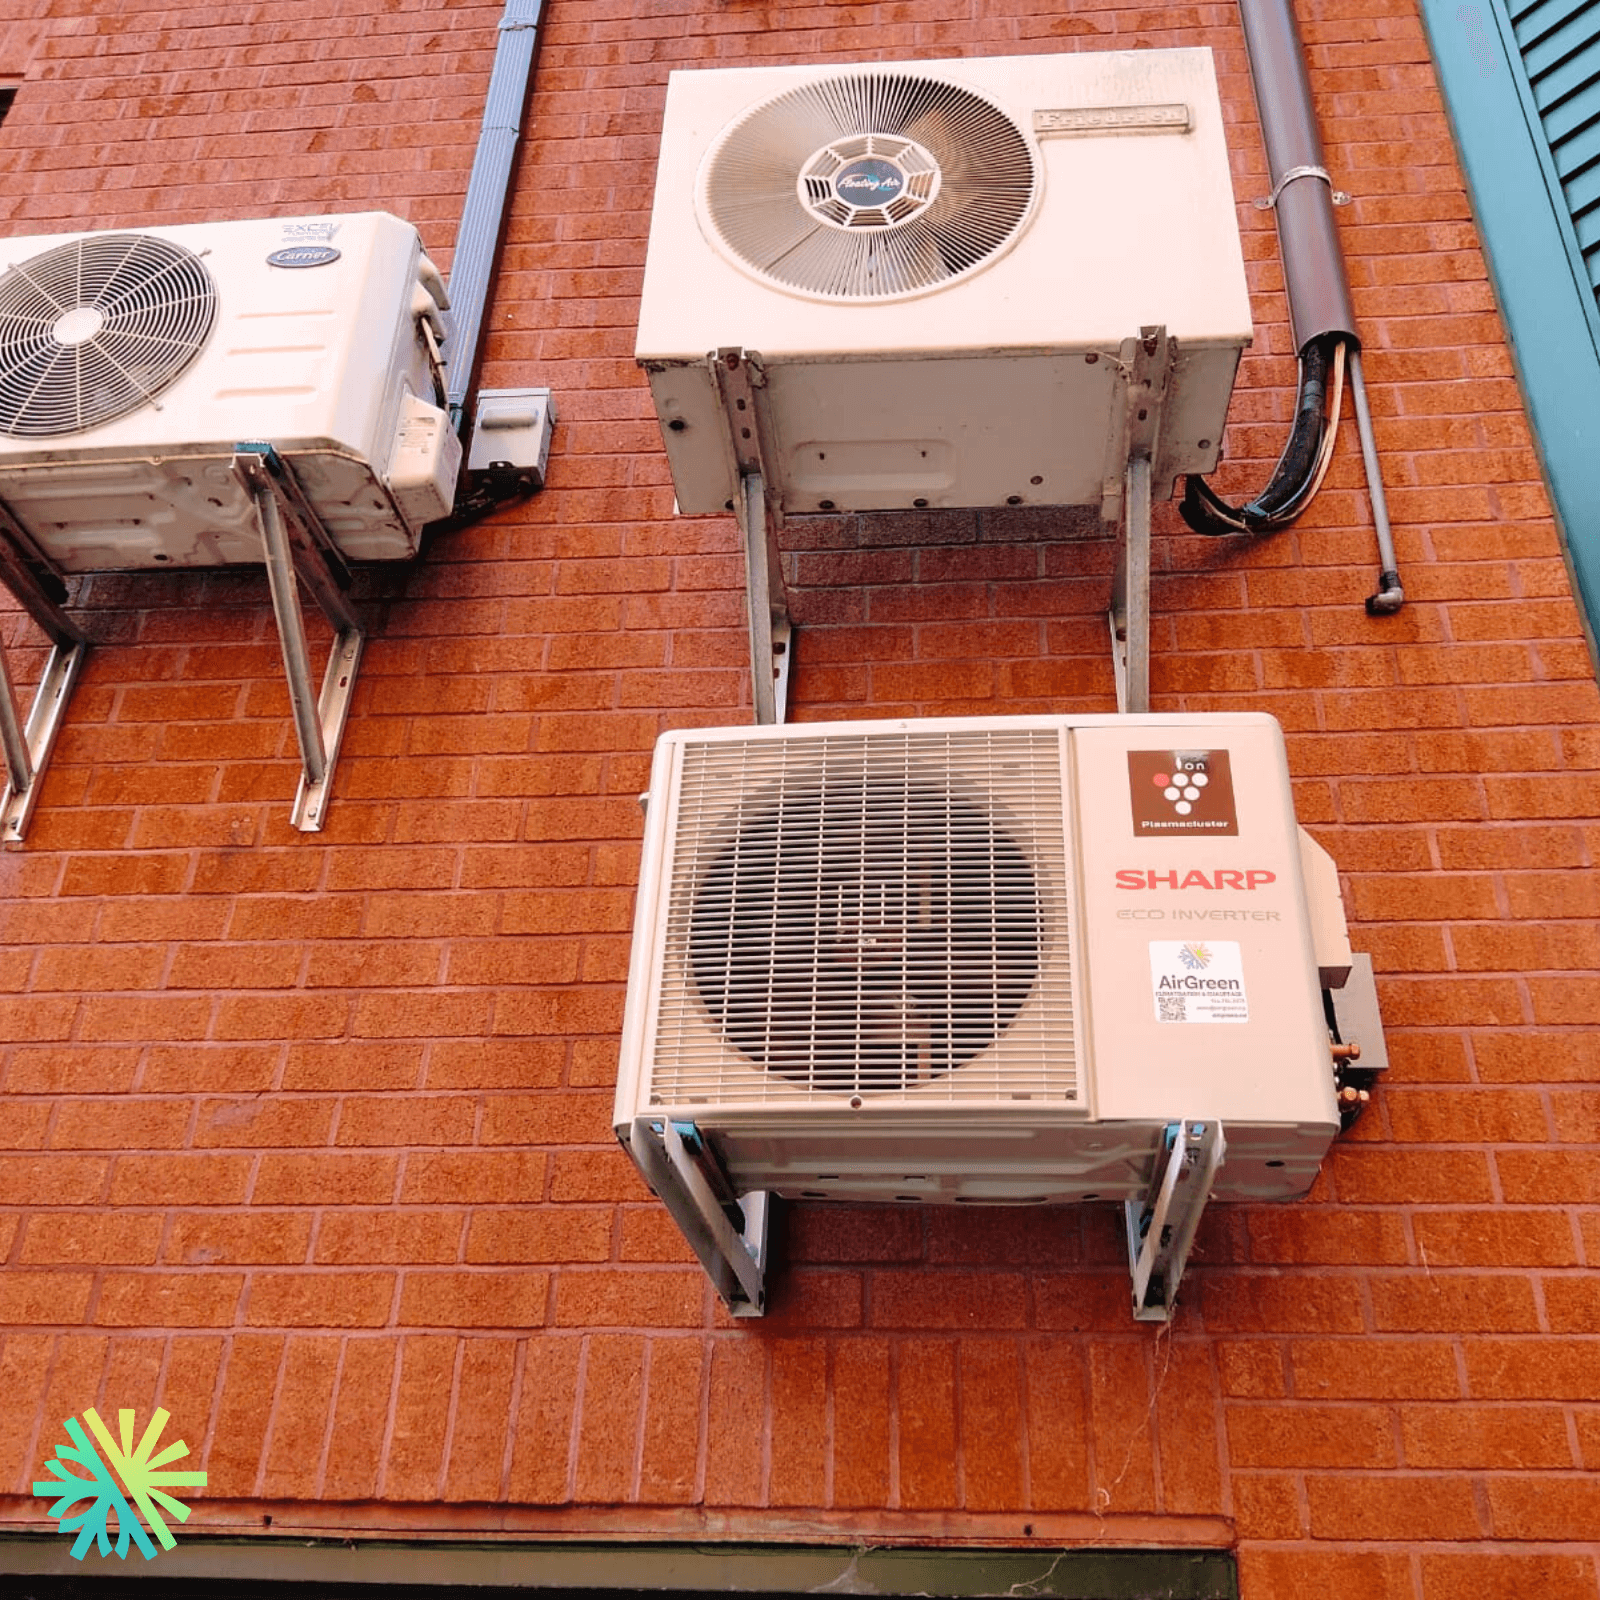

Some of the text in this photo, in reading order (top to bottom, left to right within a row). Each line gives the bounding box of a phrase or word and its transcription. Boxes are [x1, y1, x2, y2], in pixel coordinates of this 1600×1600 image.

[837, 174, 901, 191] Floating Air
[276, 250, 331, 261] Carrier
[1141, 820, 1230, 829] Plasmacluster
[1115, 869, 1277, 890] SHARP
[1116, 909, 1281, 922] ECO INVERTER
[1158, 974, 1240, 990] AirGreen
